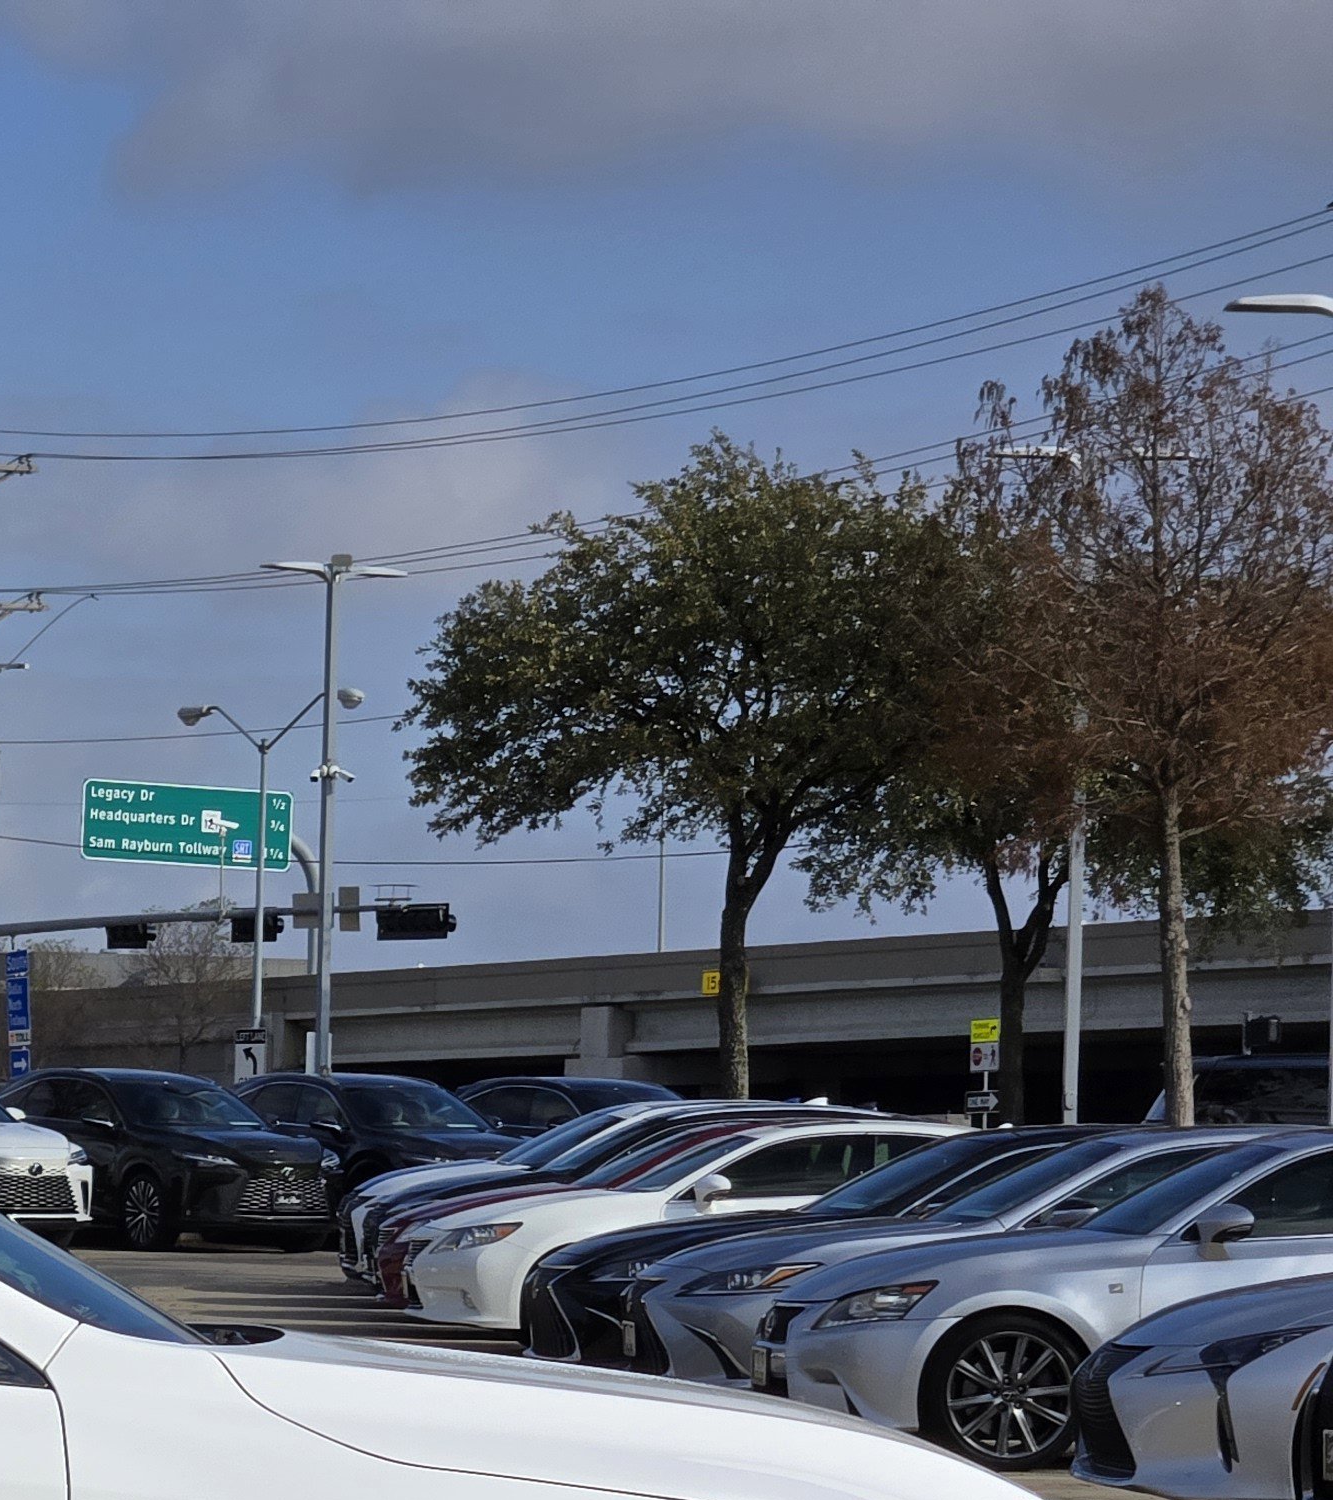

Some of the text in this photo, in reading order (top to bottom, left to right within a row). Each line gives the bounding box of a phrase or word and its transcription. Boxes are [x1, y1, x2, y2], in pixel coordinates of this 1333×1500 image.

[91, 786, 155, 802] Legacy Dr
[90, 808, 196, 826] Headquarters Dr
[89, 836, 227, 856] Sam Rayburn Tollway
[235, 842, 249, 854] SRT
